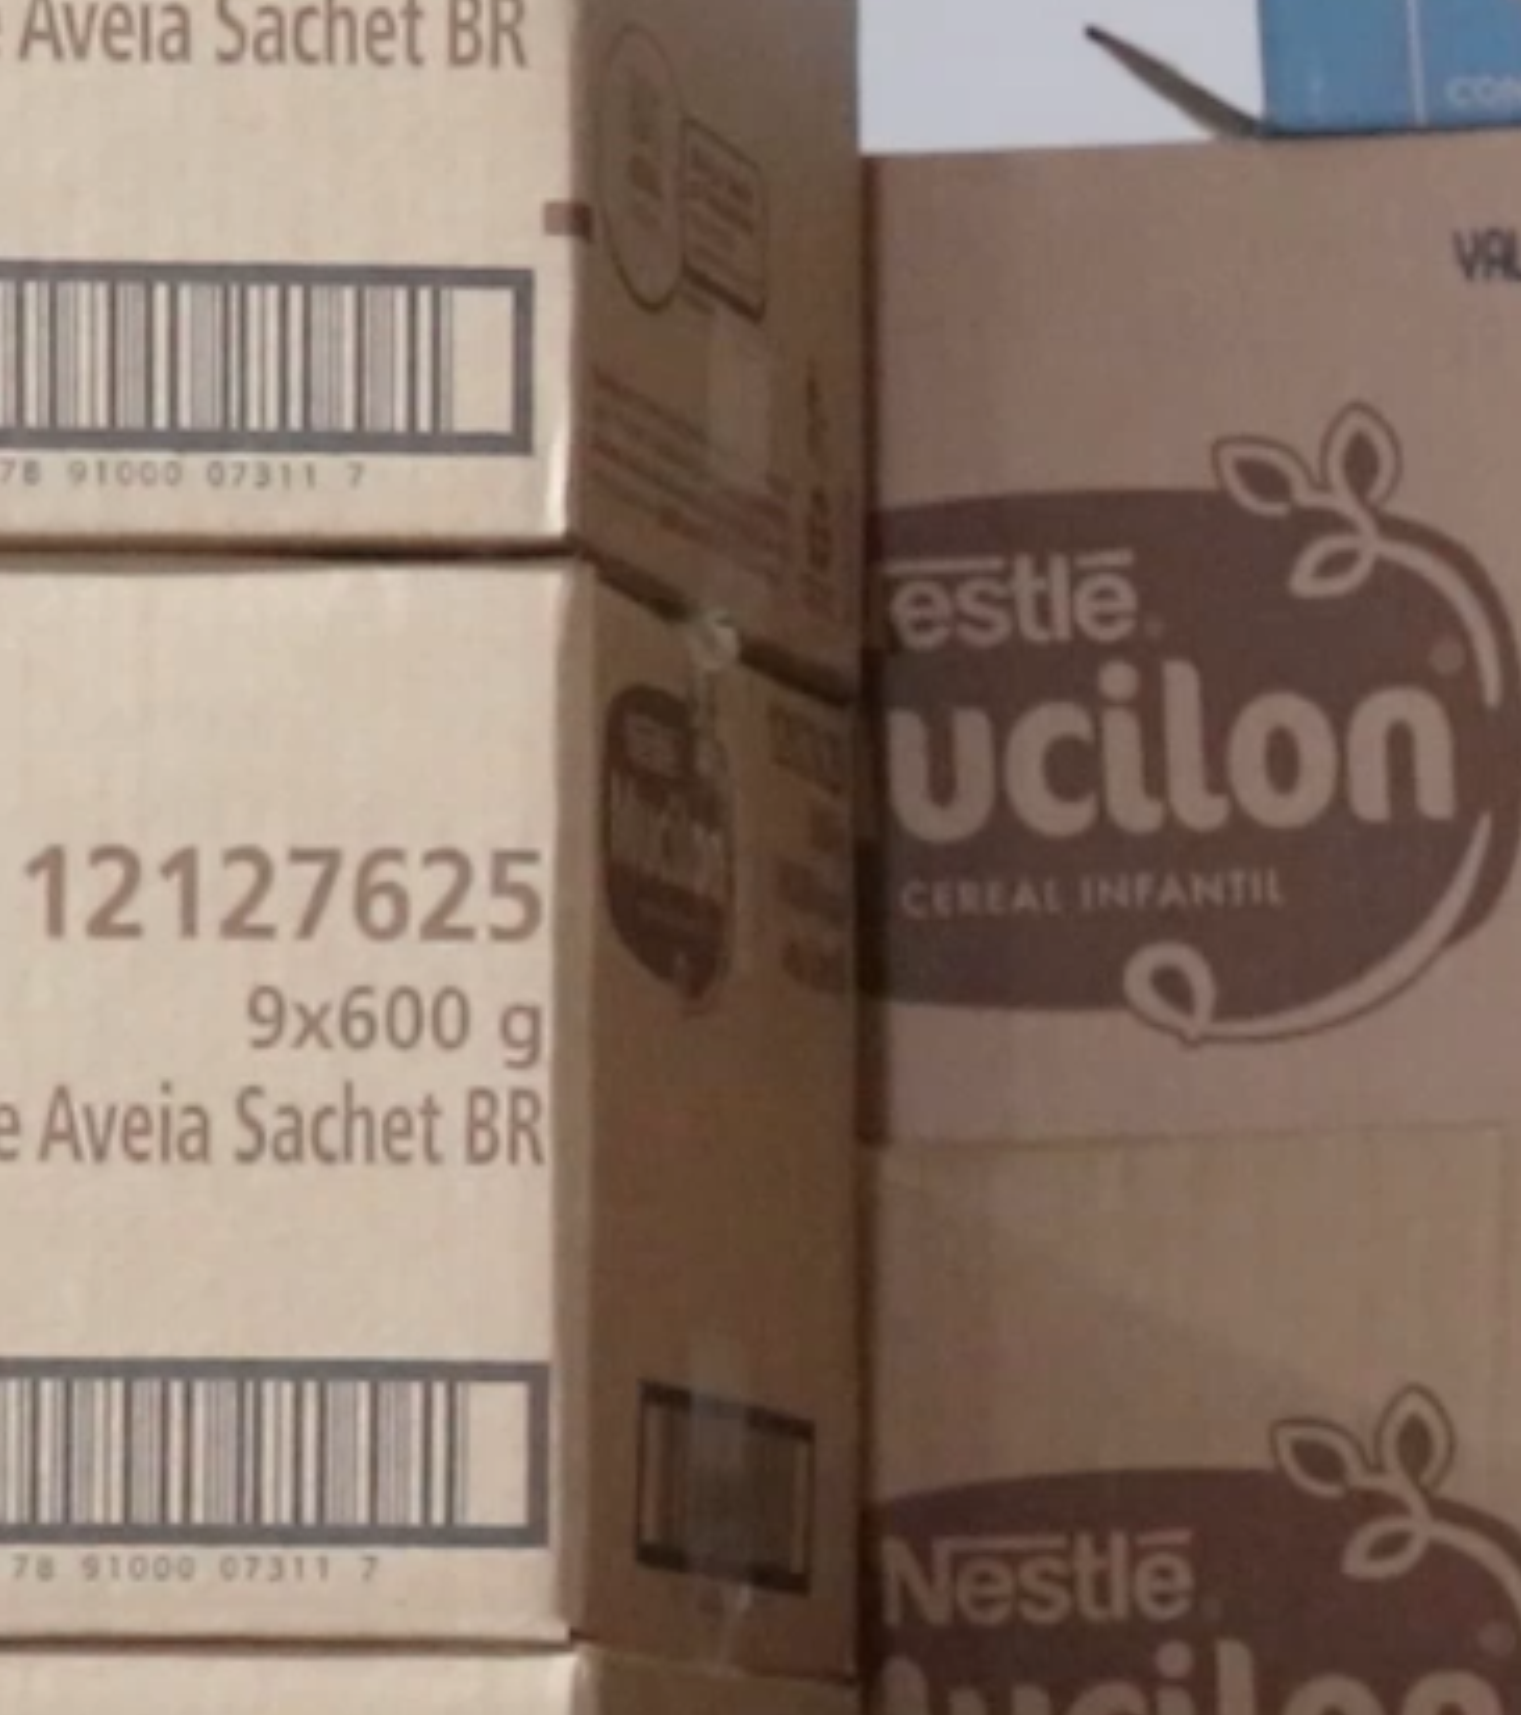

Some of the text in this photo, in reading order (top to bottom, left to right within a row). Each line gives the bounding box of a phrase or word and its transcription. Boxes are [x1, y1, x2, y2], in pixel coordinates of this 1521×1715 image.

[18, 0, 528, 69] Aveia Sachet BR
[68, 460, 182, 487] 91000
[207, 461, 317, 488] 07311
[347, 462, 366, 488] 7
[888, 549, 1136, 649] estlé
[886, 659, 1456, 844] ucilon
[23, 847, 544, 942] 12127625
[901, 867, 1283, 918] CEREAL INFANTIL
[247, 985, 543, 1068] 9x600 g
[37, 1079, 211, 1164] Aveia
[234, 1080, 443, 1166] Sachet
[466, 1088, 545, 1166] BR
[11, 1553, 381, 1584] 78 91000 07311 7
[881, 1529, 1194, 1628] Nestlé
